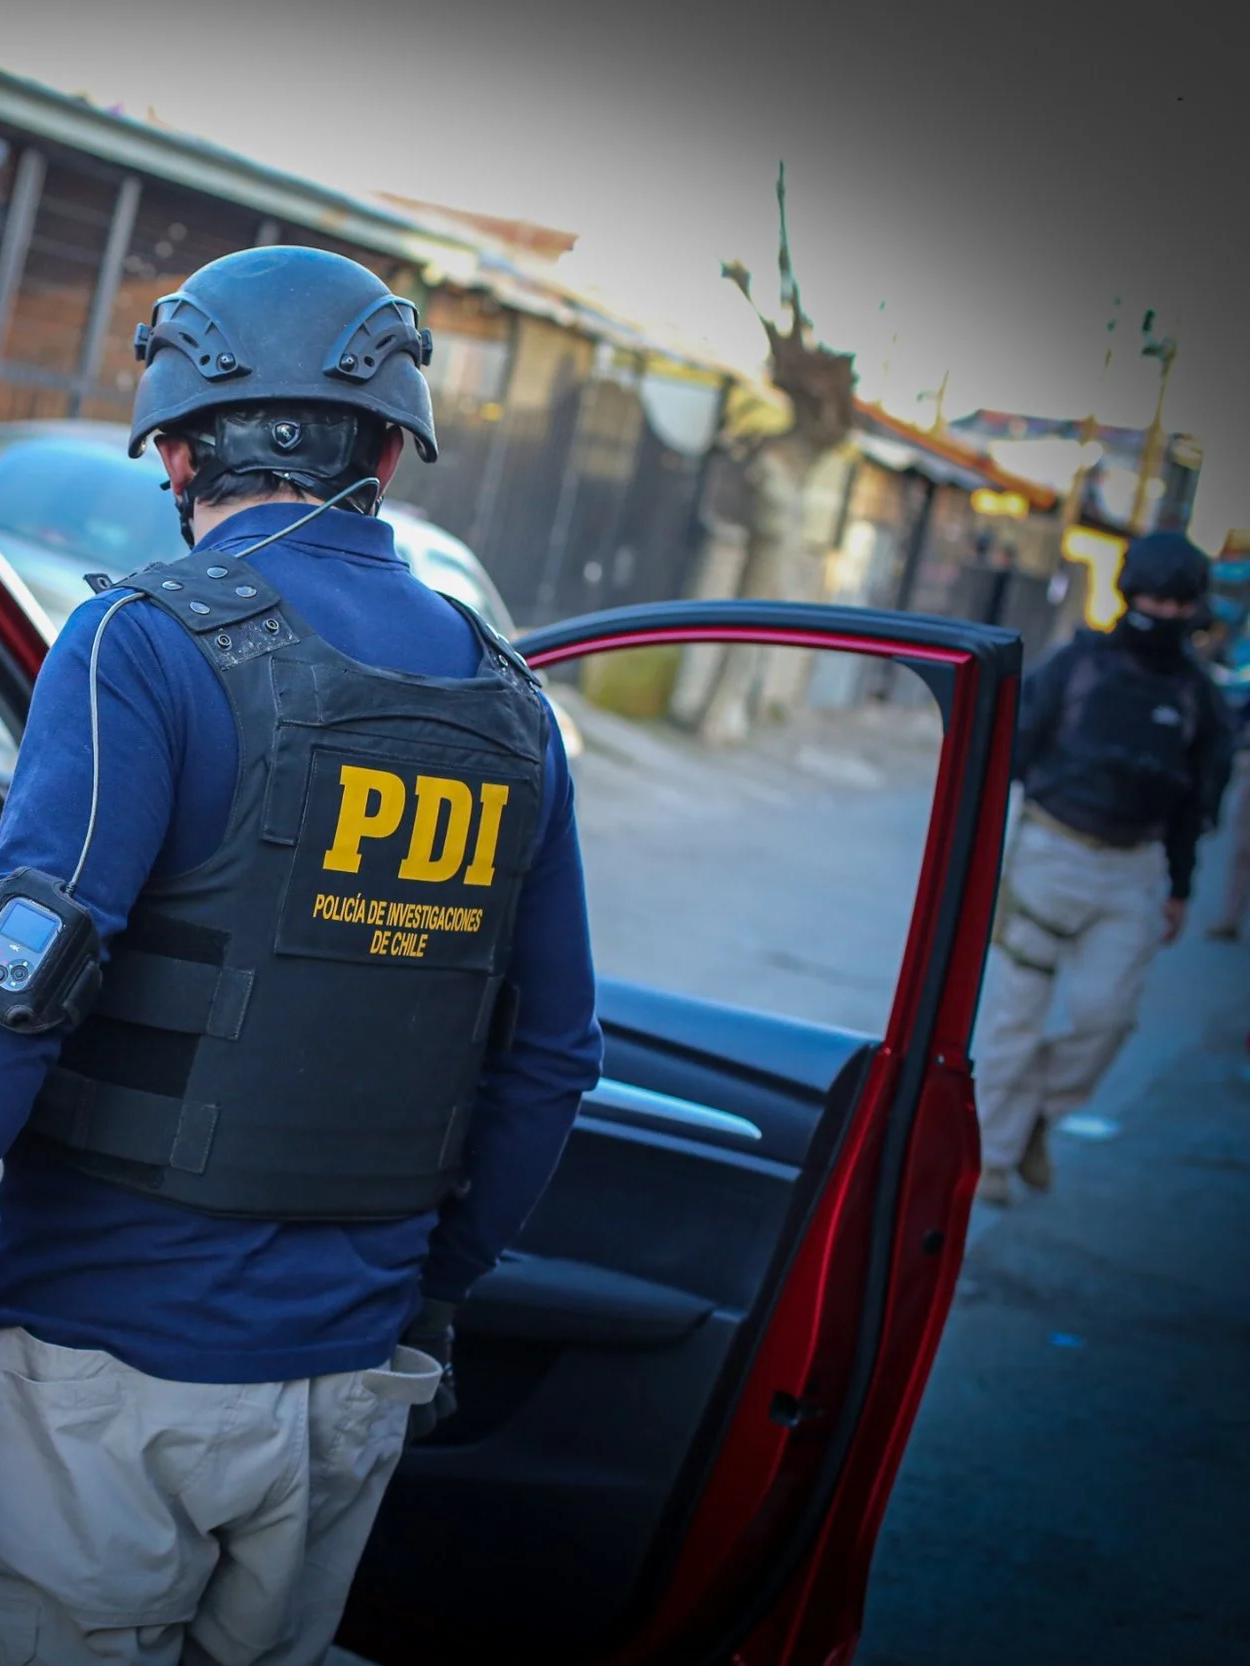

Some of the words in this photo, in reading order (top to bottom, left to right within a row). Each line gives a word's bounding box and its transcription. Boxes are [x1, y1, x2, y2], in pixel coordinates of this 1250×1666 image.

[322, 765, 509, 886] PDI
[313, 892, 366, 923] POLICÍA
[367, 900, 385, 926] DE
[386, 902, 483, 932] INVESTIGACIONES
[370, 930, 390, 955] DE
[391, 932, 428, 957] CHILE
